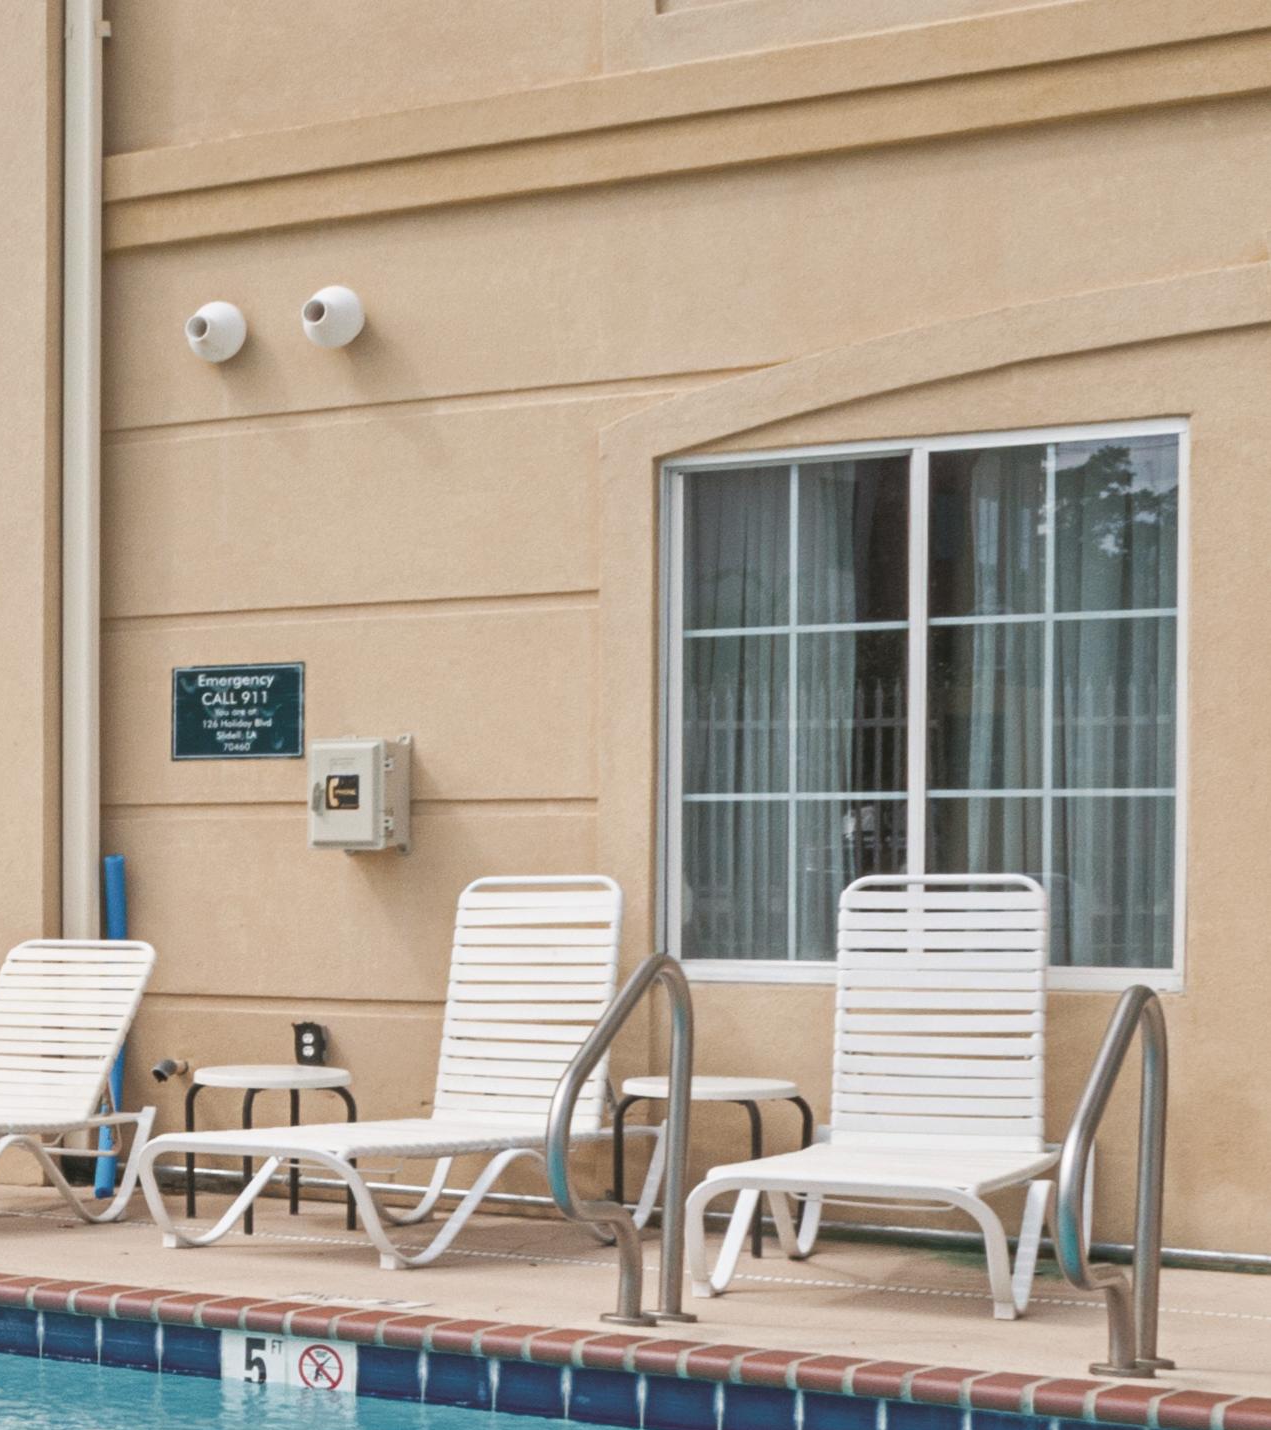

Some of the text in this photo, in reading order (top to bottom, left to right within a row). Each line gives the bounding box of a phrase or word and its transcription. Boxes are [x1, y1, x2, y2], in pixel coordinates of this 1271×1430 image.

[197, 674, 275, 689] Emergency
[201, 691, 267, 705] CALL 911
[202, 717, 273, 729] 126 Holiday Blvd
[246, 730, 257, 740] LA
[244, 1337, 283, 1384] 5 FT
